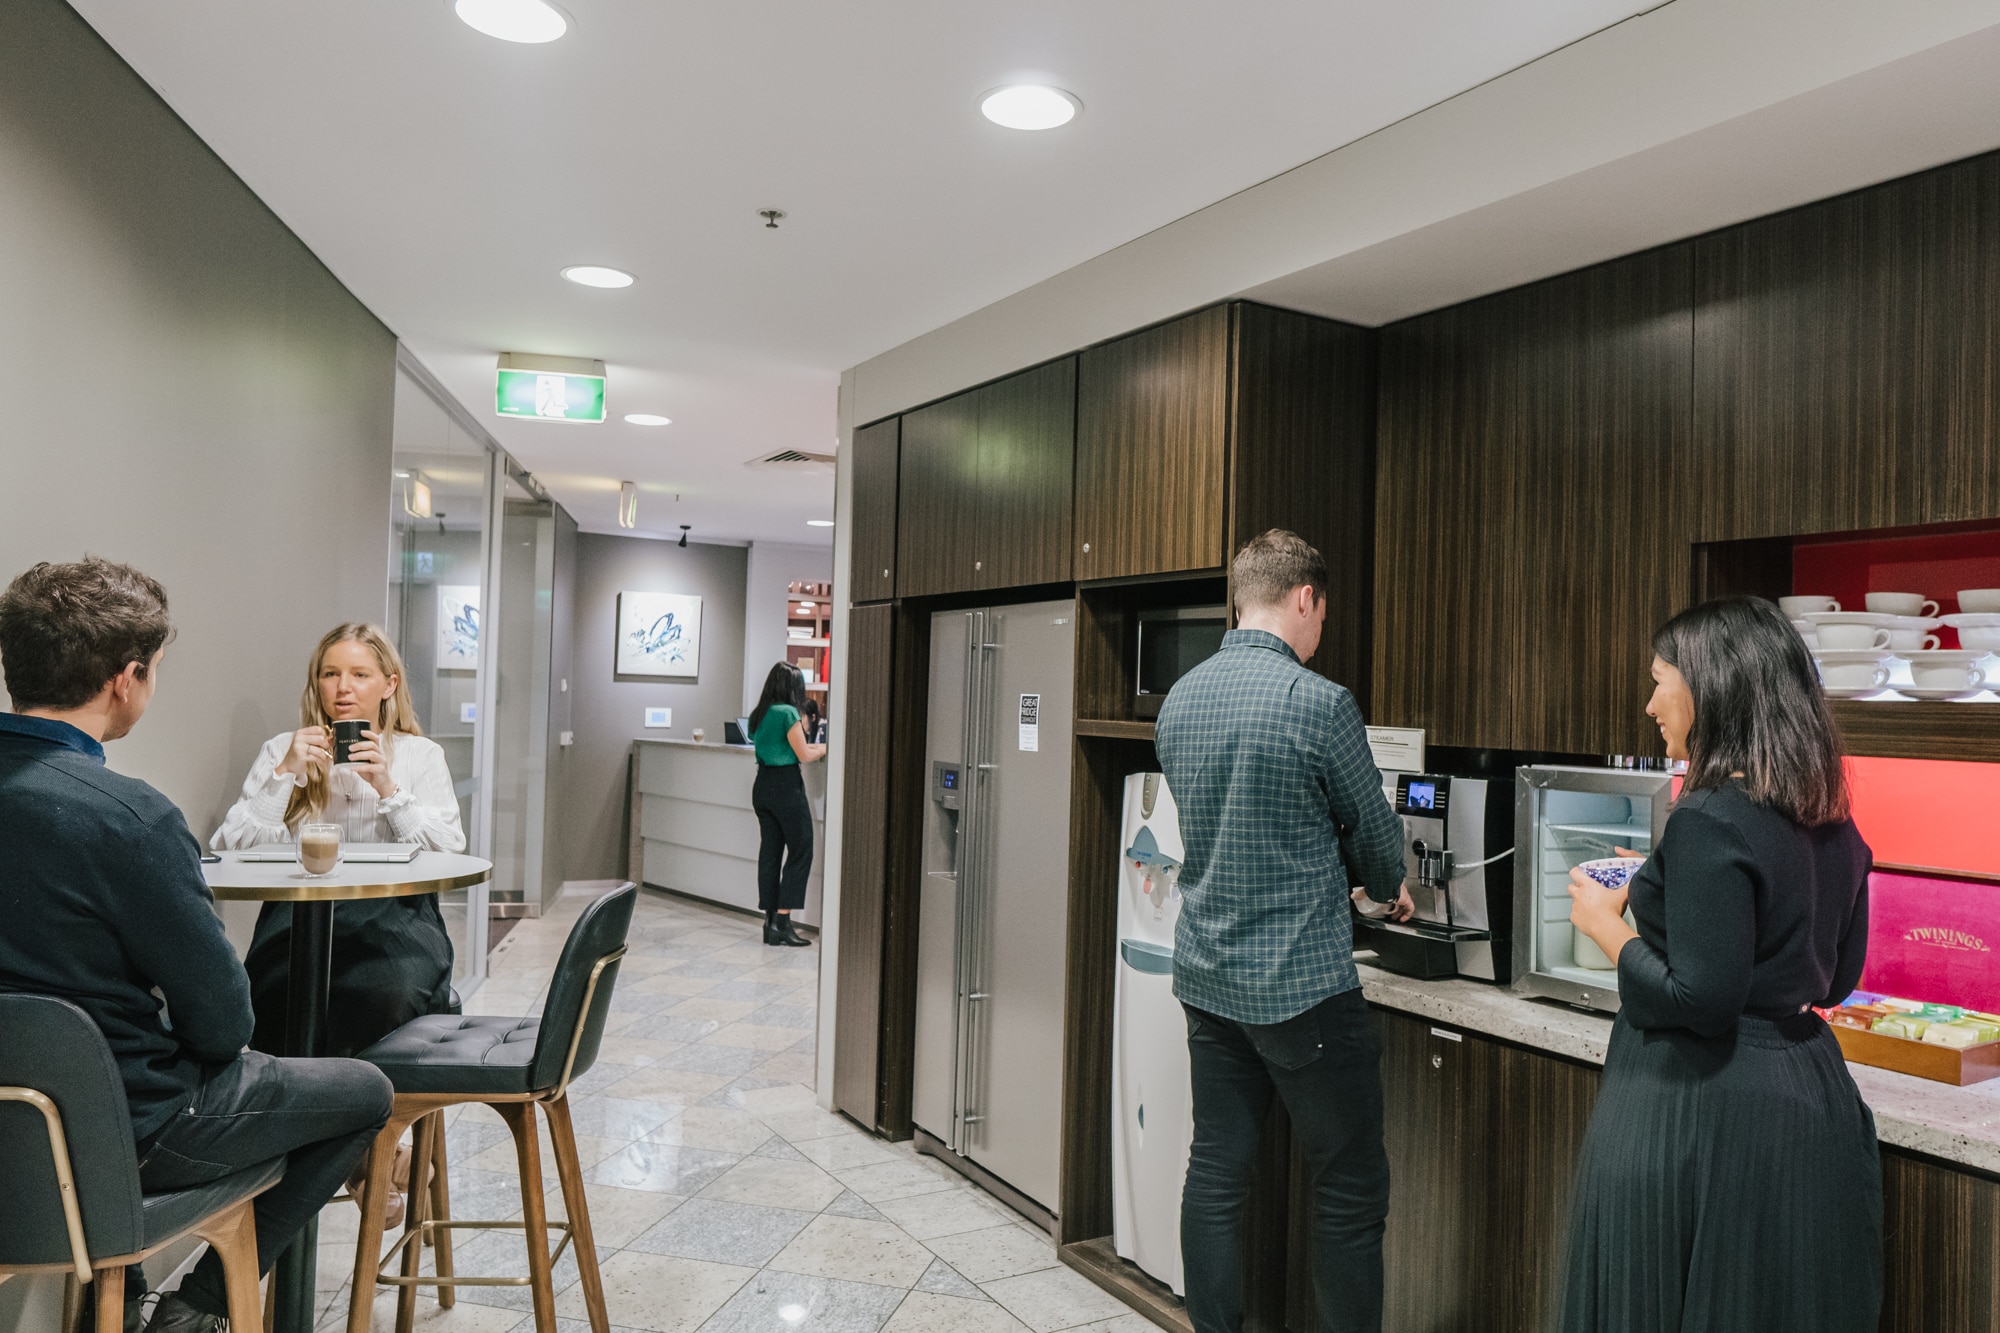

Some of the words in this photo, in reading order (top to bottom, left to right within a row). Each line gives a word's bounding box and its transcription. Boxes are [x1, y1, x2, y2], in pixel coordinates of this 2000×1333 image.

[1023, 698, 1038, 707] GREAT
[1021, 707, 1037, 716] FRIDGE
[1909, 927, 1983, 950] TWININGS
